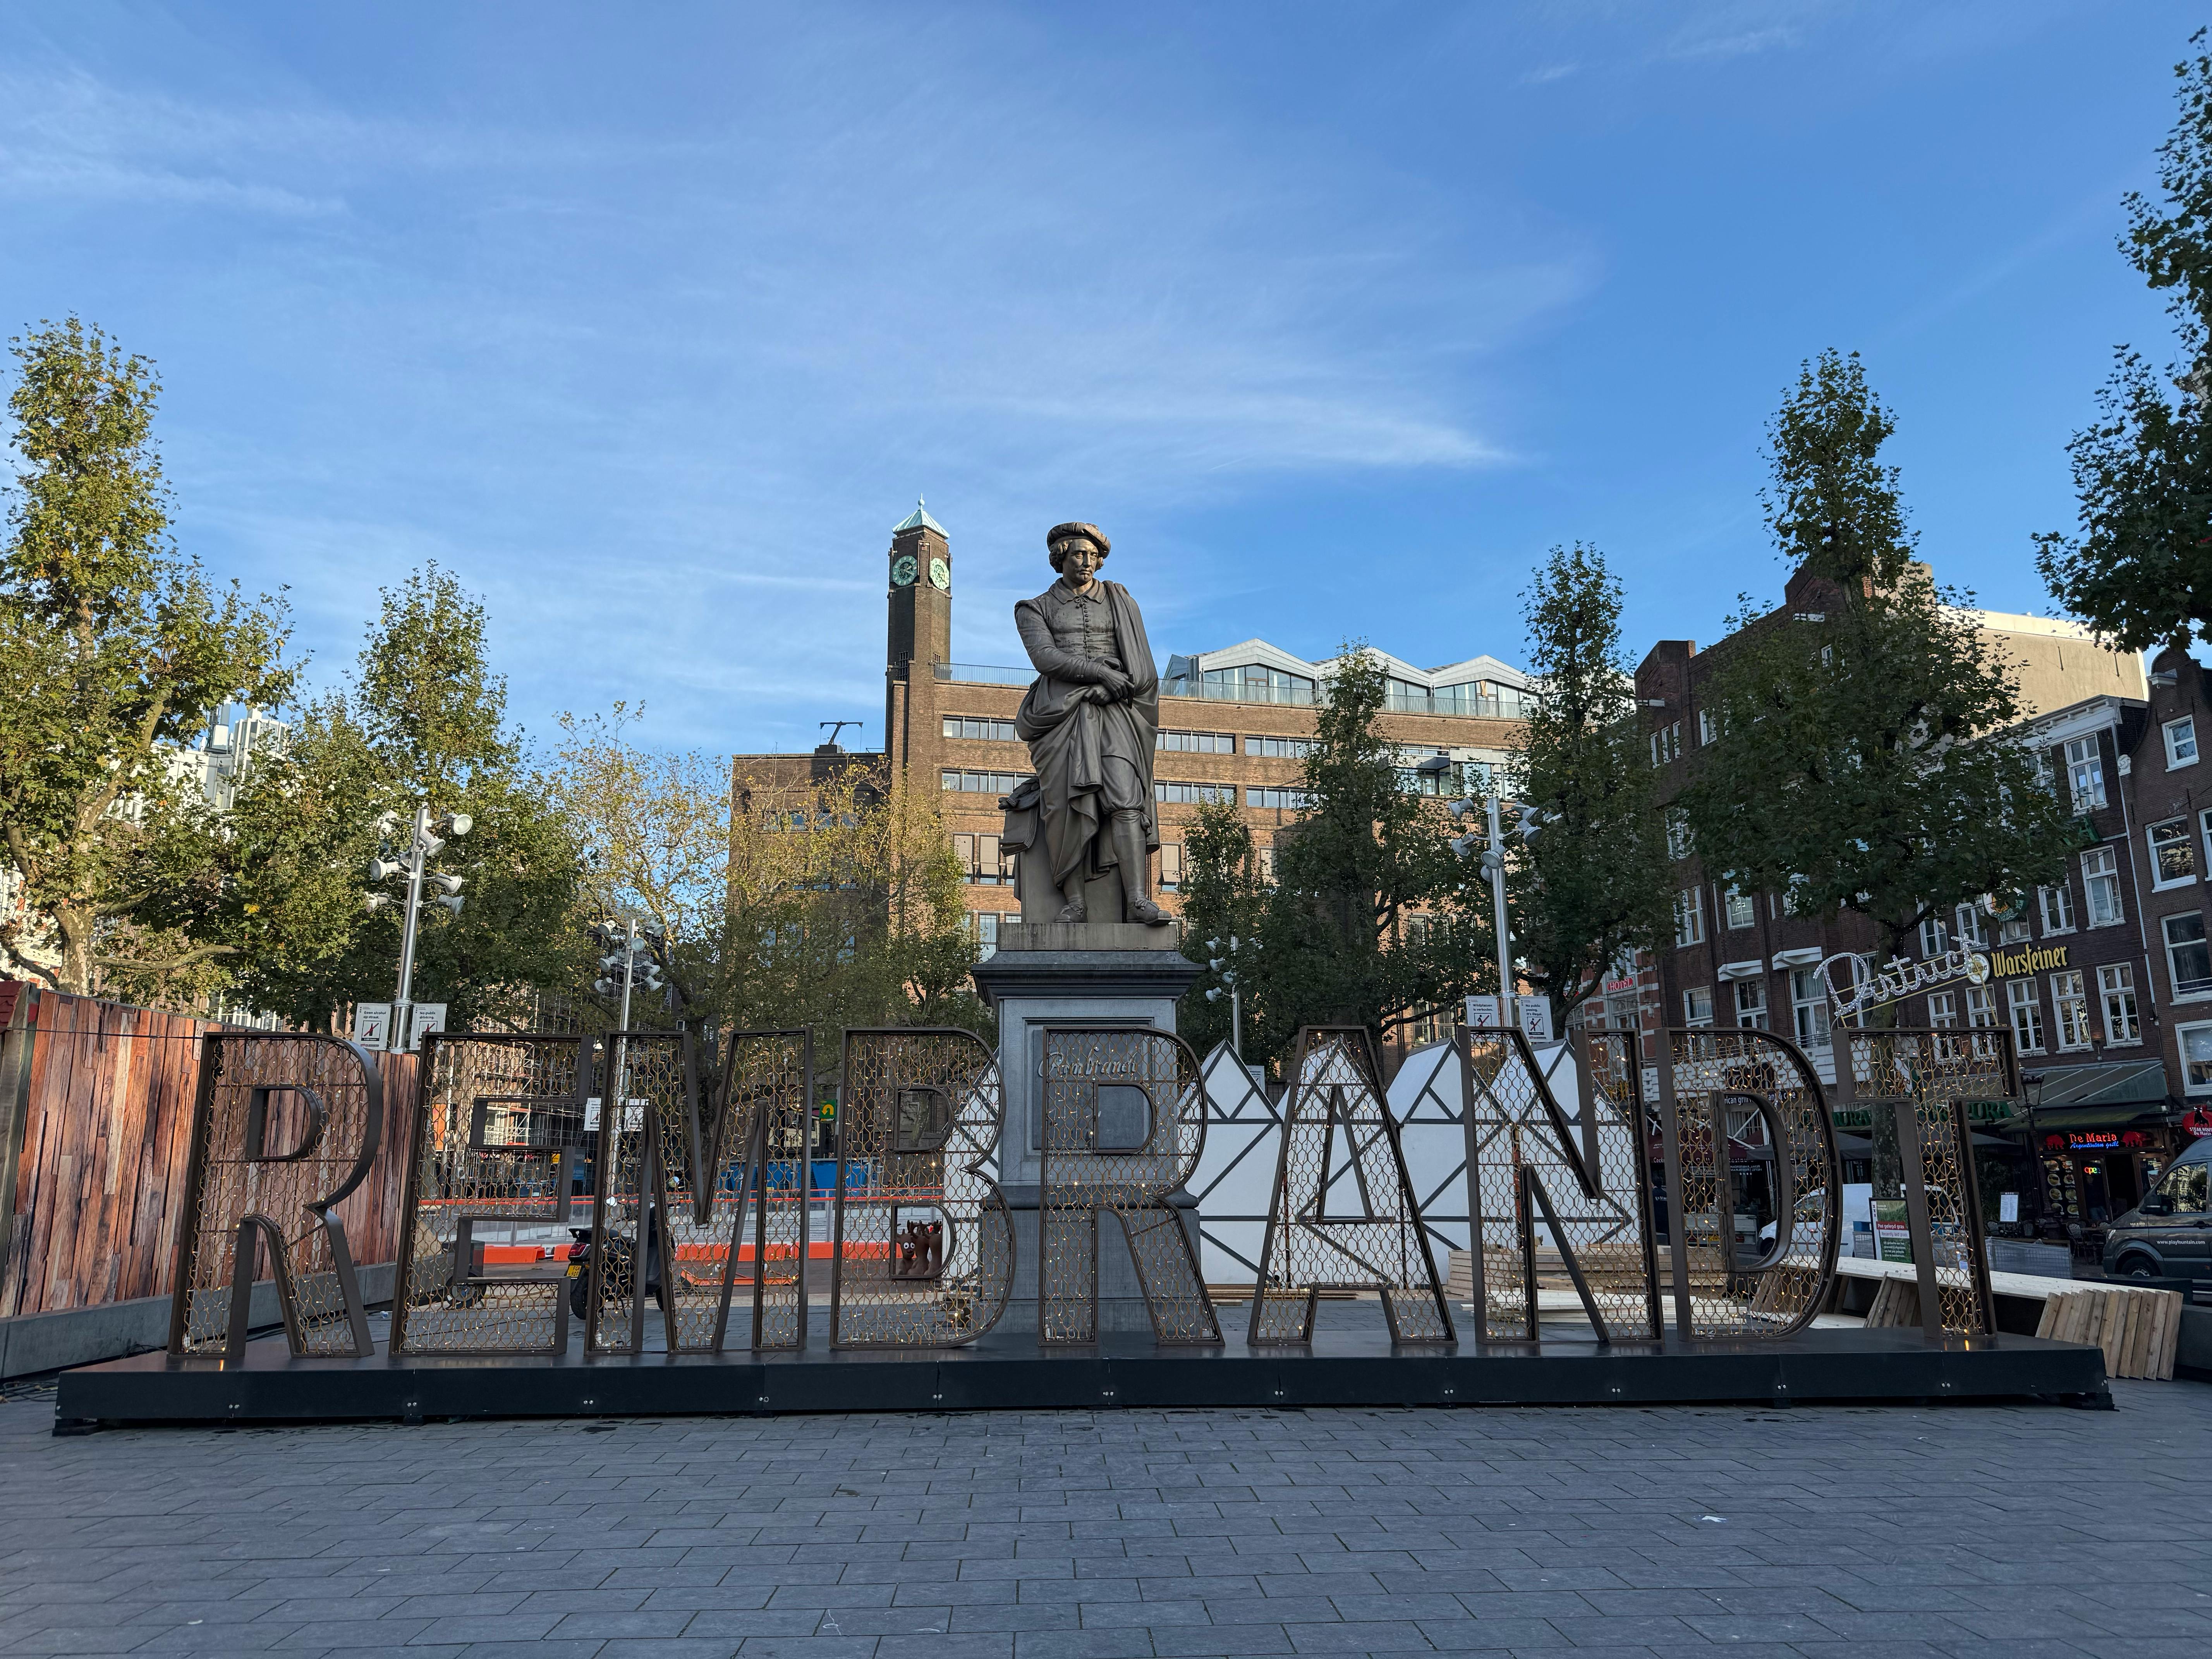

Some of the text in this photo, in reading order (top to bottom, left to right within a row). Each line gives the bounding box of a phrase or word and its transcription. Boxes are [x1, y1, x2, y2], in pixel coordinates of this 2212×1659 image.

[1991, 943, 2068, 978] Warsteiner
[1610, 978, 1632, 991] HOTEL
[2069, 1132, 2117, 1143] De Maria
[168, 1025, 2022, 1358] REMBRANDT
